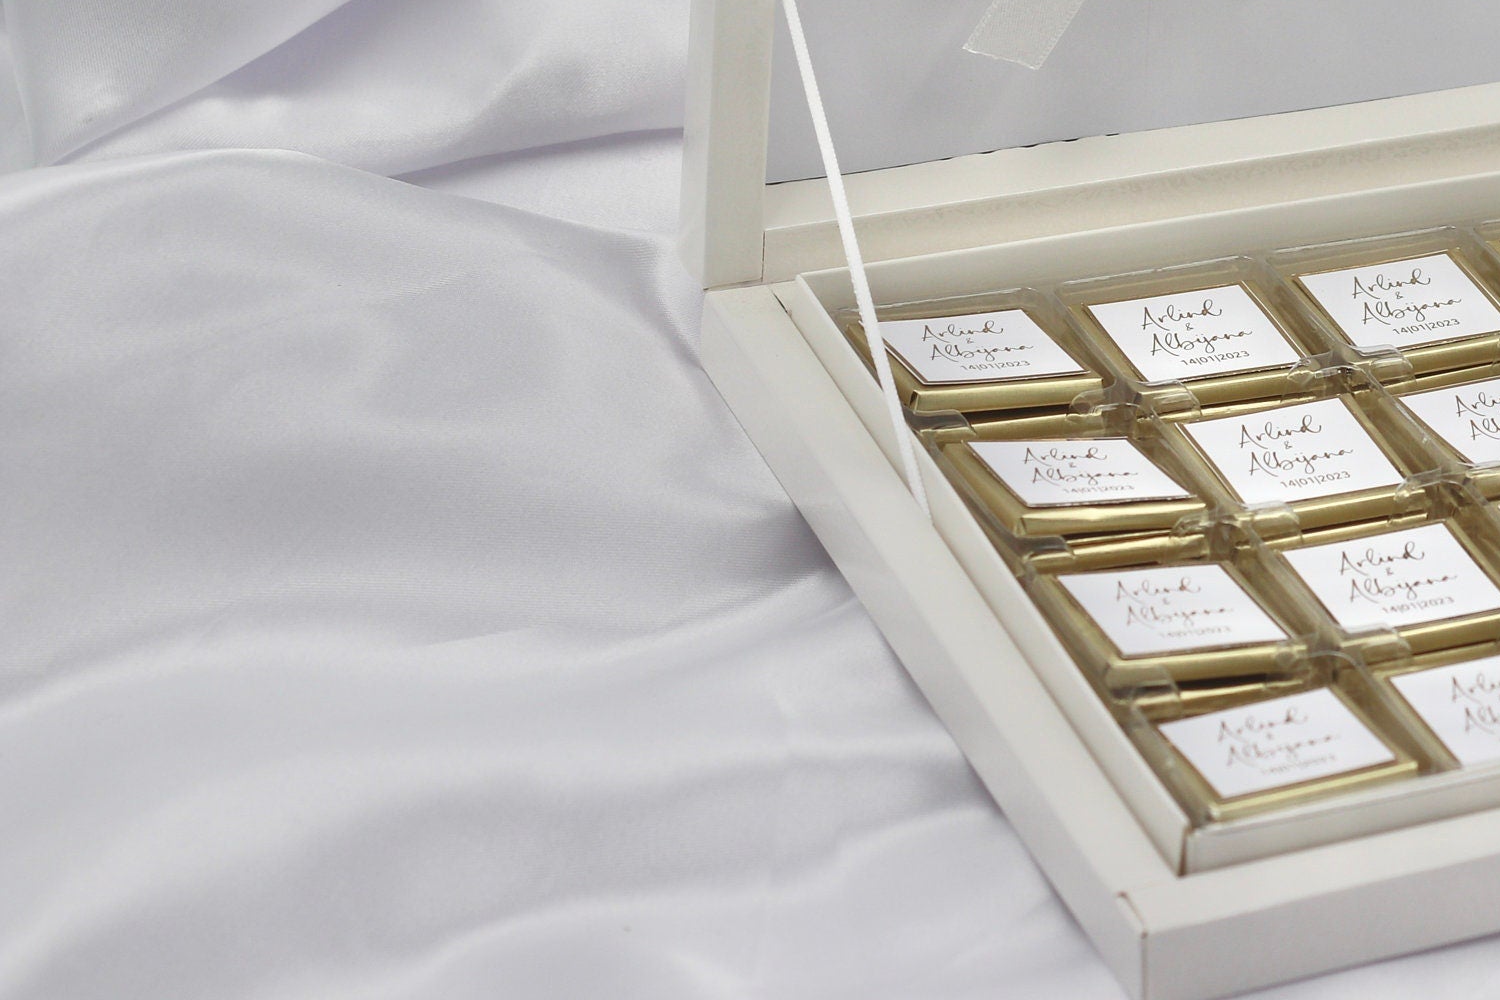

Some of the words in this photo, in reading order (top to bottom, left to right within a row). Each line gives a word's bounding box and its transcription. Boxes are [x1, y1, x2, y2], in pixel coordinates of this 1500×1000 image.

[1351, 268, 1432, 301] Arlind
[1141, 299, 1223, 332] Arlind
[1362, 299, 1461, 327] Albijana
[923, 321, 1005, 345] Arlind
[1150, 331, 1253, 357] Albijana
[930, 344, 1038, 364] Albijana
[1239, 415, 1322, 451] Arlind
[1023, 447, 1109, 468] Arlind
[1248, 449, 1355, 478] Albijana
[1339, 540, 1426, 577] Arlind
